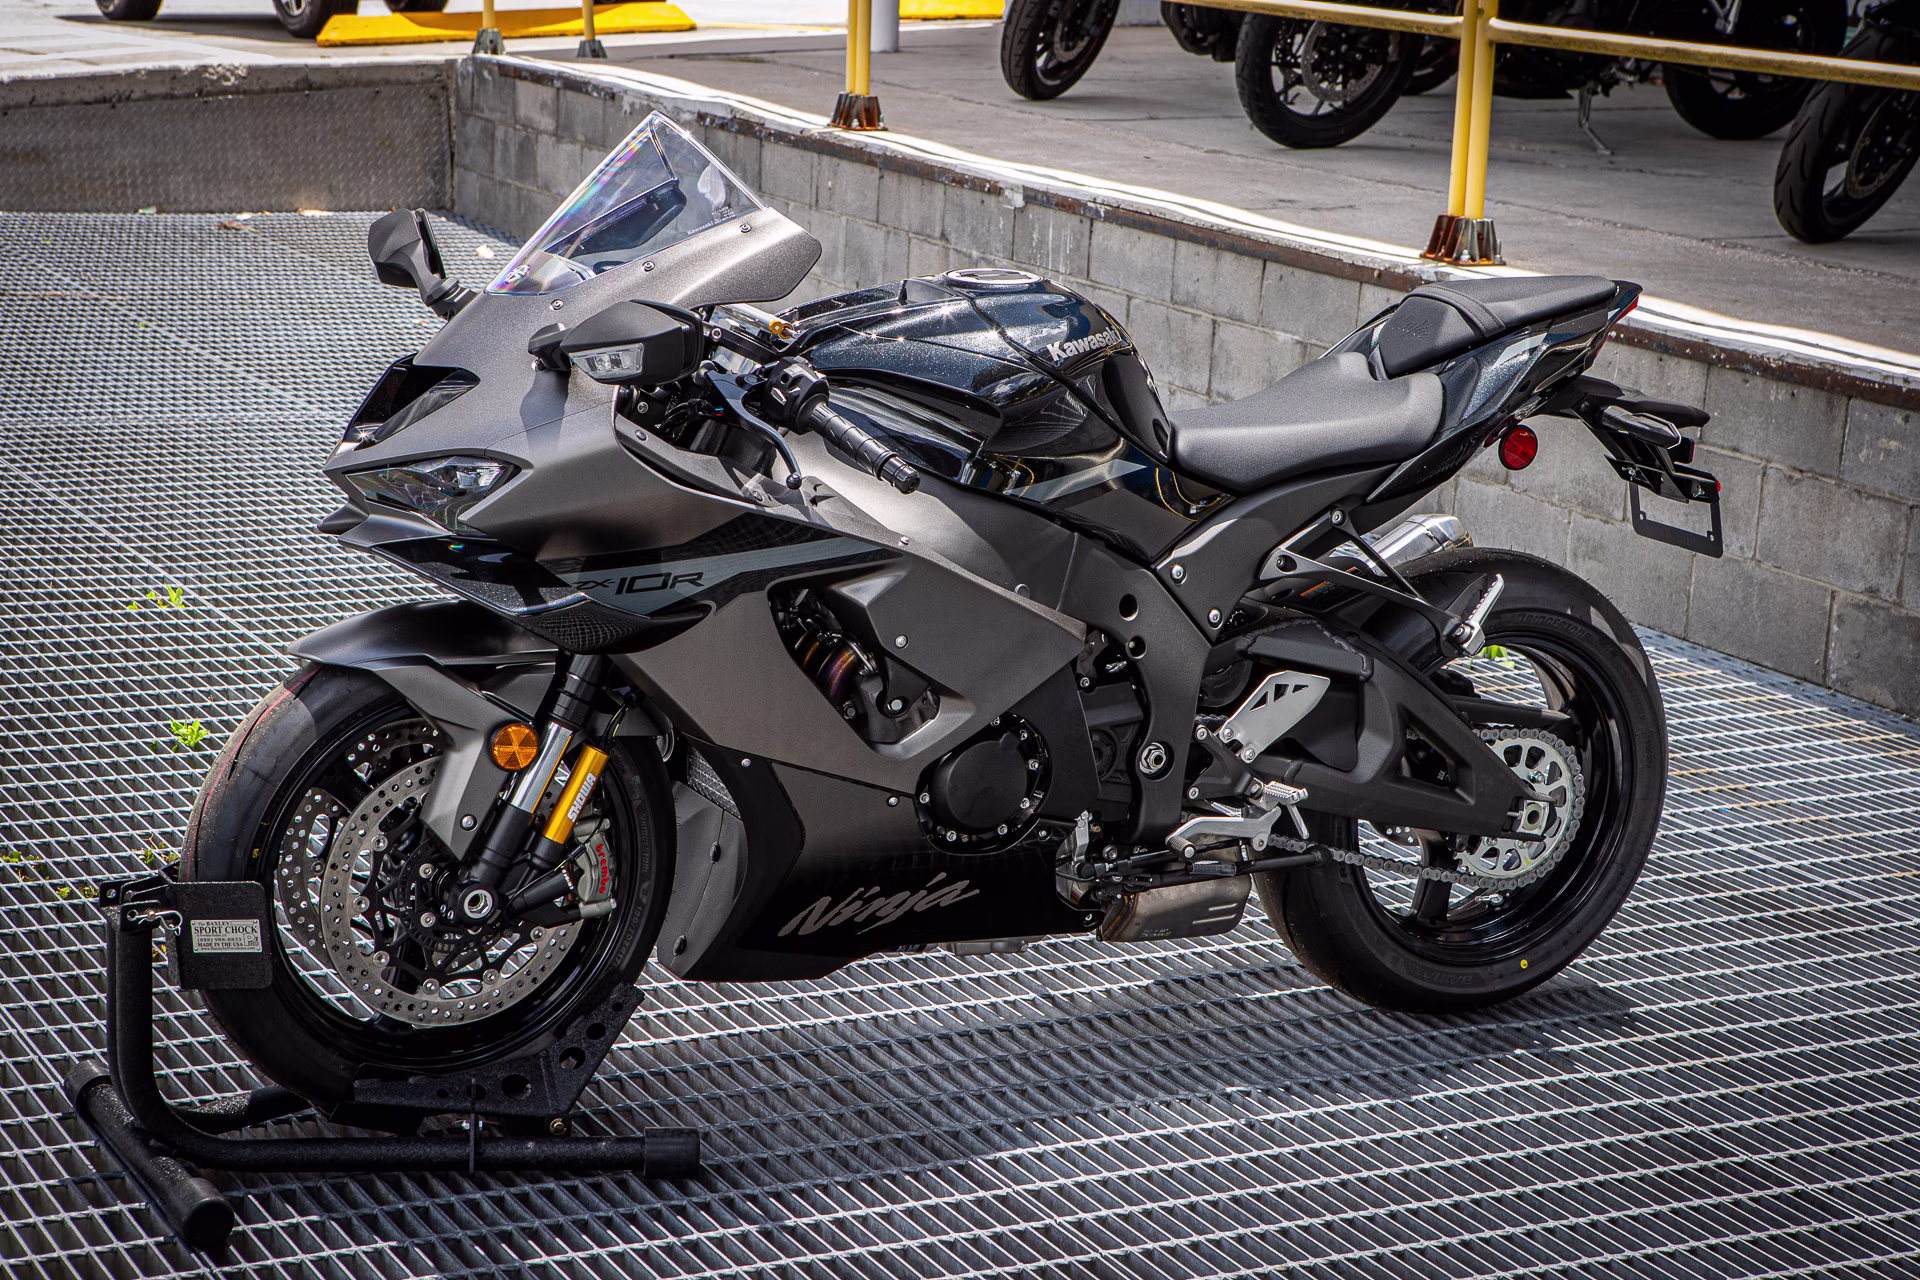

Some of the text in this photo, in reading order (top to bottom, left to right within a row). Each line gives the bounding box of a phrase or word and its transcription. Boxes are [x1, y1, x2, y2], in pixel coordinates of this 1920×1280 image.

[567, 772, 597, 823] SHOWA
[596, 841, 610, 894] brembo
[194, 926, 258, 934] SPORT CHOCK
[777, 872, 980, 937] Ninja
